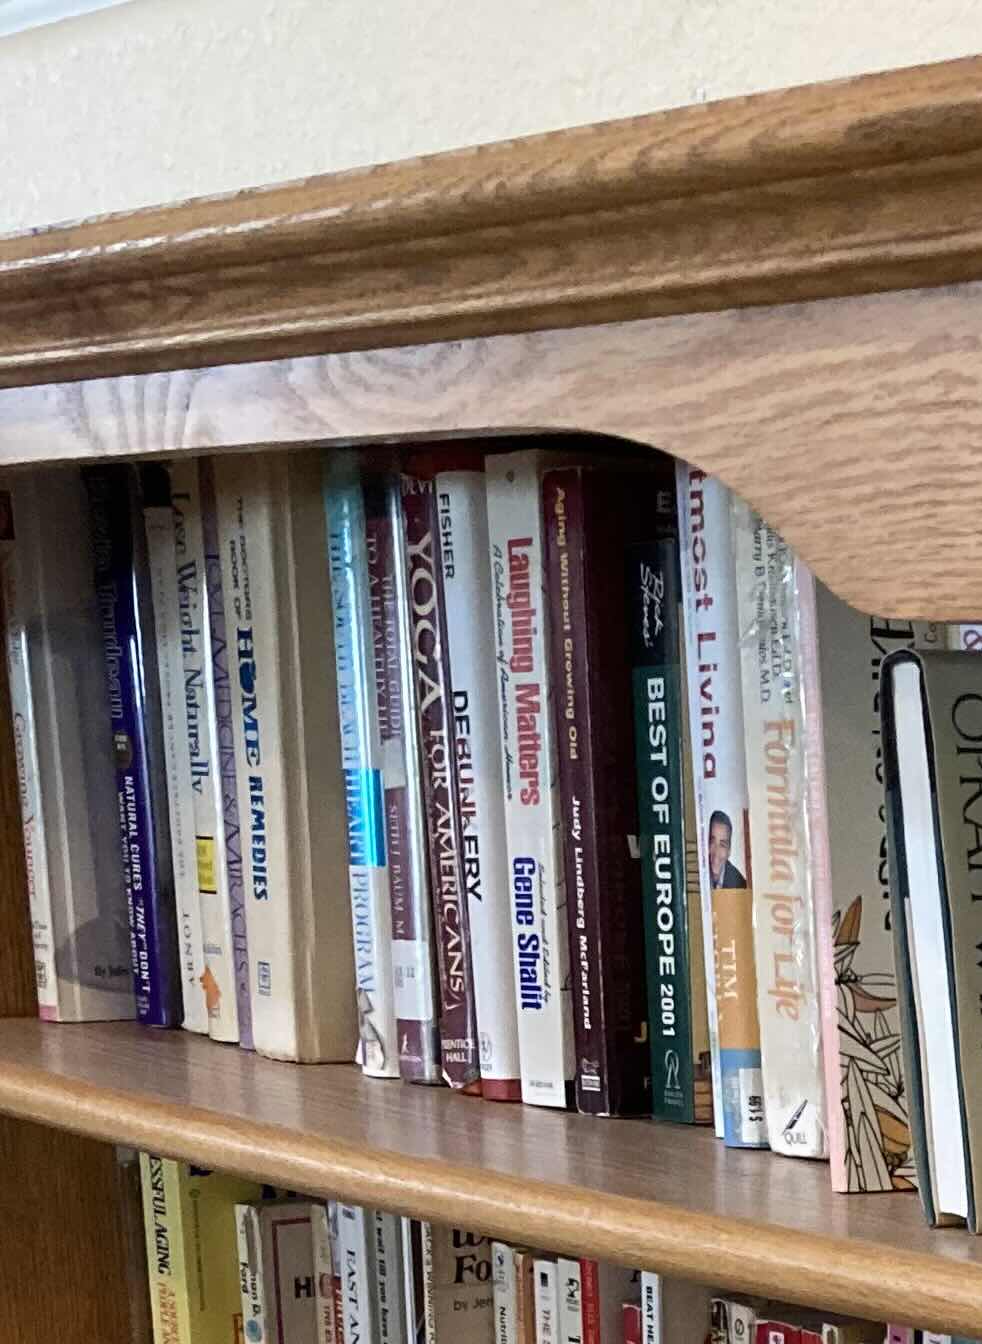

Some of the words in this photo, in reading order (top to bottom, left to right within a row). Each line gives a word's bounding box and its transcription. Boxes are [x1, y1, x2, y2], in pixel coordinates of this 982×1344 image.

[176, 491, 193, 555] Lose
[439, 493, 456, 580] FISHER
[554, 487, 567, 546] Aging
[180, 560, 202, 655] Weight
[406, 533, 443, 717] YOGA
[493, 561, 508, 646] Celebration
[505, 536, 537, 673] Laughing
[557, 552, 571, 630] Without
[563, 638, 577, 720] Growing
[696, 631, 718, 780] Living
[185, 668, 209, 795] Naturally
[427, 726, 448, 791] FOR
[513, 684, 543, 806] Matters
[568, 726, 579, 759] Old
[646, 677, 669, 766] BEST
[234, 626, 262, 768] HOME
[248, 775, 271, 901] REMEDIES
[651, 776, 671, 824] OF
[762, 719, 800, 881] Formula
[123, 775, 138, 839] NATURAL
[570, 795, 583, 840] Judy
[130, 844, 143, 892] CURES
[223, 817, 250, 972] MIRACLES
[432, 801, 464, 996] AMERICANS
[513, 856, 538, 925] Gene
[573, 846, 588, 928] Lindberg
[653, 833, 677, 977] EUROPE
[351, 871, 380, 998] PROGRAM
[762, 892, 804, 944] for
[138, 951, 151, 993] DON'T
[520, 932, 544, 1011] Shalit
[578, 935, 594, 1030] McFarland
[721, 938, 739, 1000] TIM
[766, 952, 808, 1021] Life
[658, 983, 676, 1037] 2001
[155, 1222, 173, 1276] AGING
[240, 1261, 252, 1295] Ford
[345, 1248, 360, 1305] EAST
[542, 1308, 553, 1337] THE
[646, 1285, 655, 1320] BEAT
